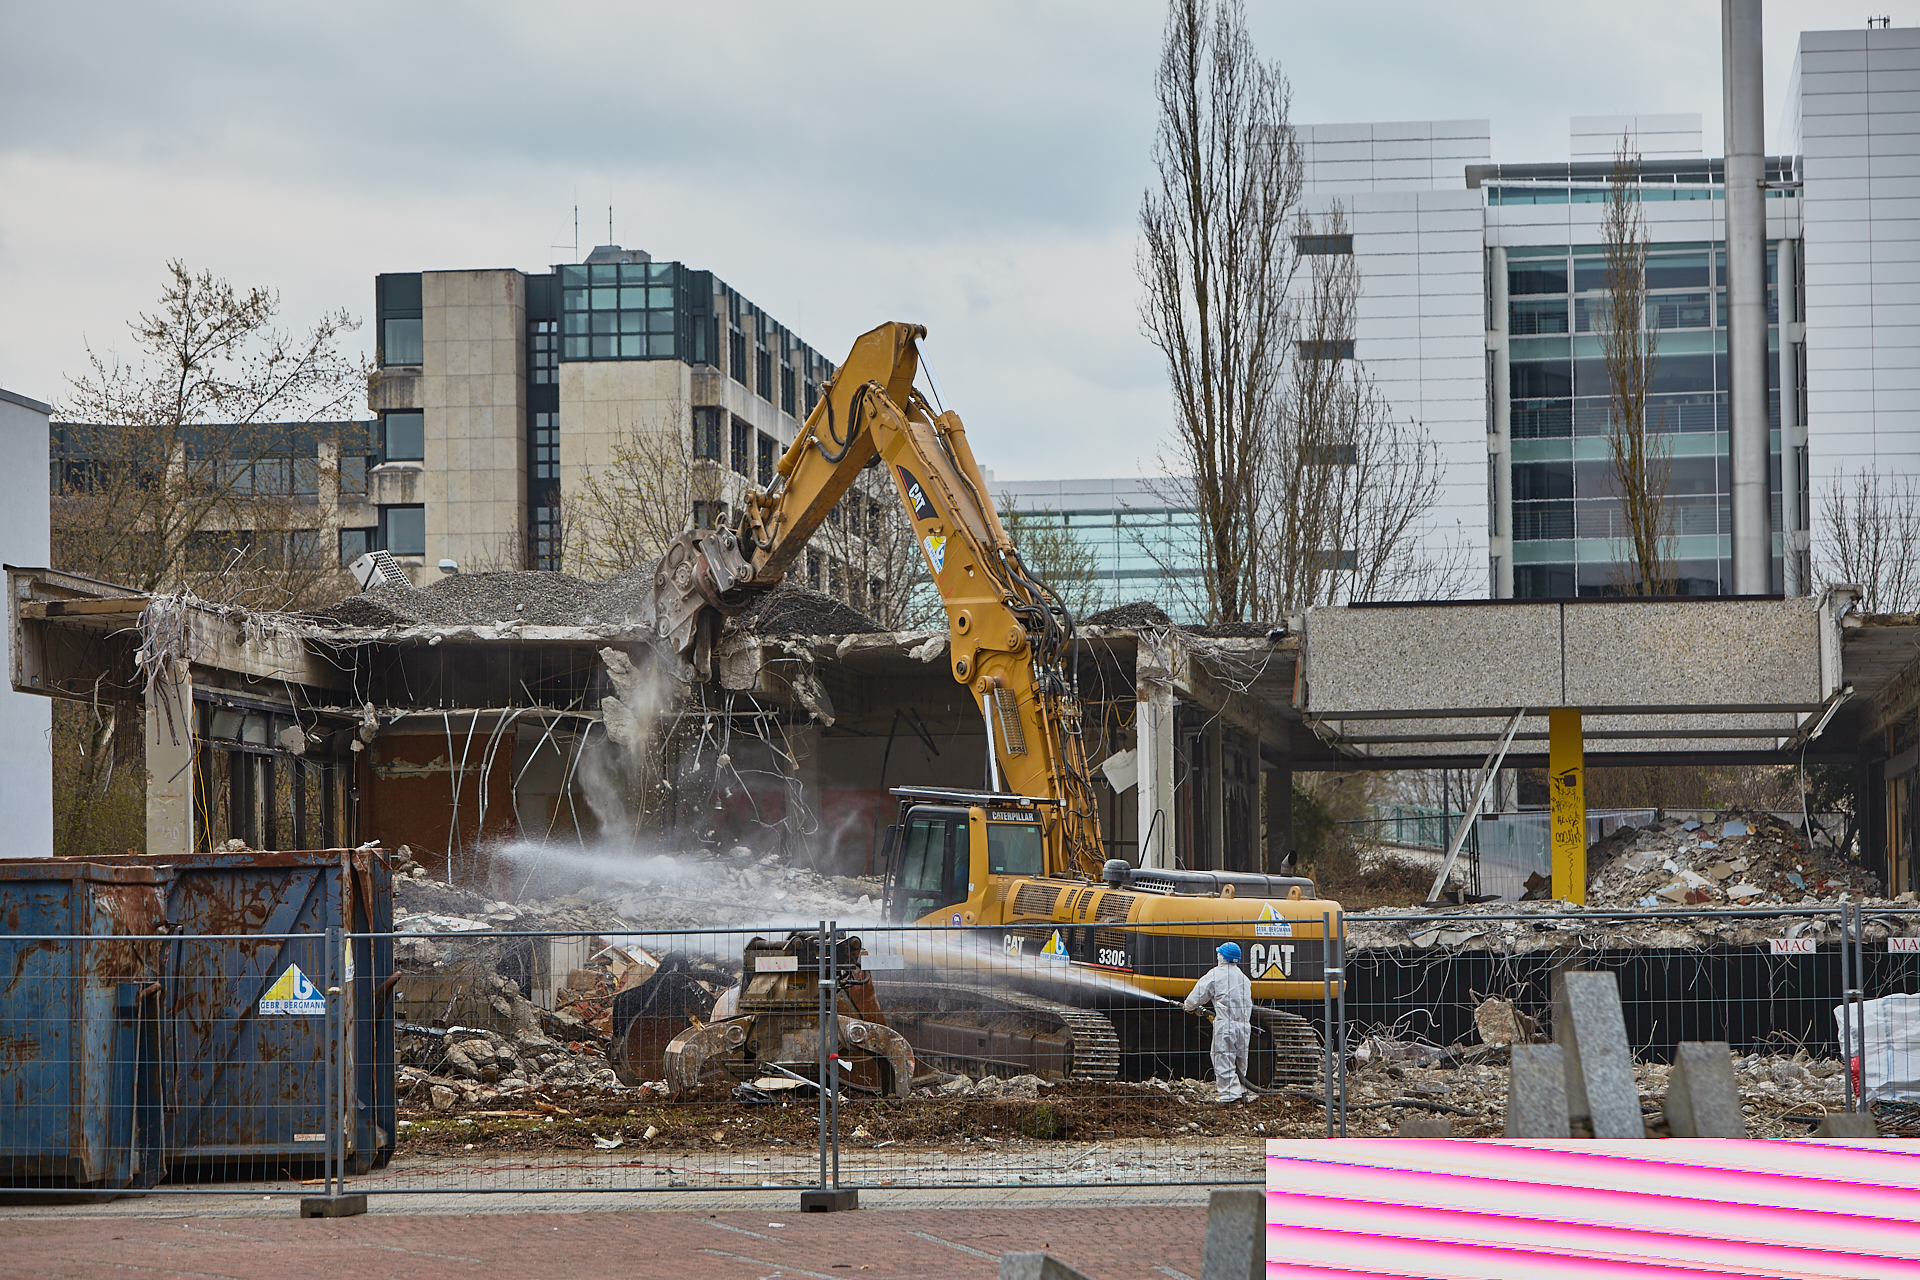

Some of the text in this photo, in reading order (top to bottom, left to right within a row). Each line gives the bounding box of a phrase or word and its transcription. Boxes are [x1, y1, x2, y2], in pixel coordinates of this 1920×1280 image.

[908, 483, 926, 513] CAT
[991, 811, 1034, 822] CATERPILLAR
[1003, 934, 1025, 956] CAT
[1775, 939, 1813, 952] MAC
[1892, 938, 1920, 951] MA
[758, 957, 794, 970] MAC
[1099, 948, 1125, 967] 330C
[1250, 943, 1295, 979] CAT
[284, 1001, 326, 1009] BERGMANN
